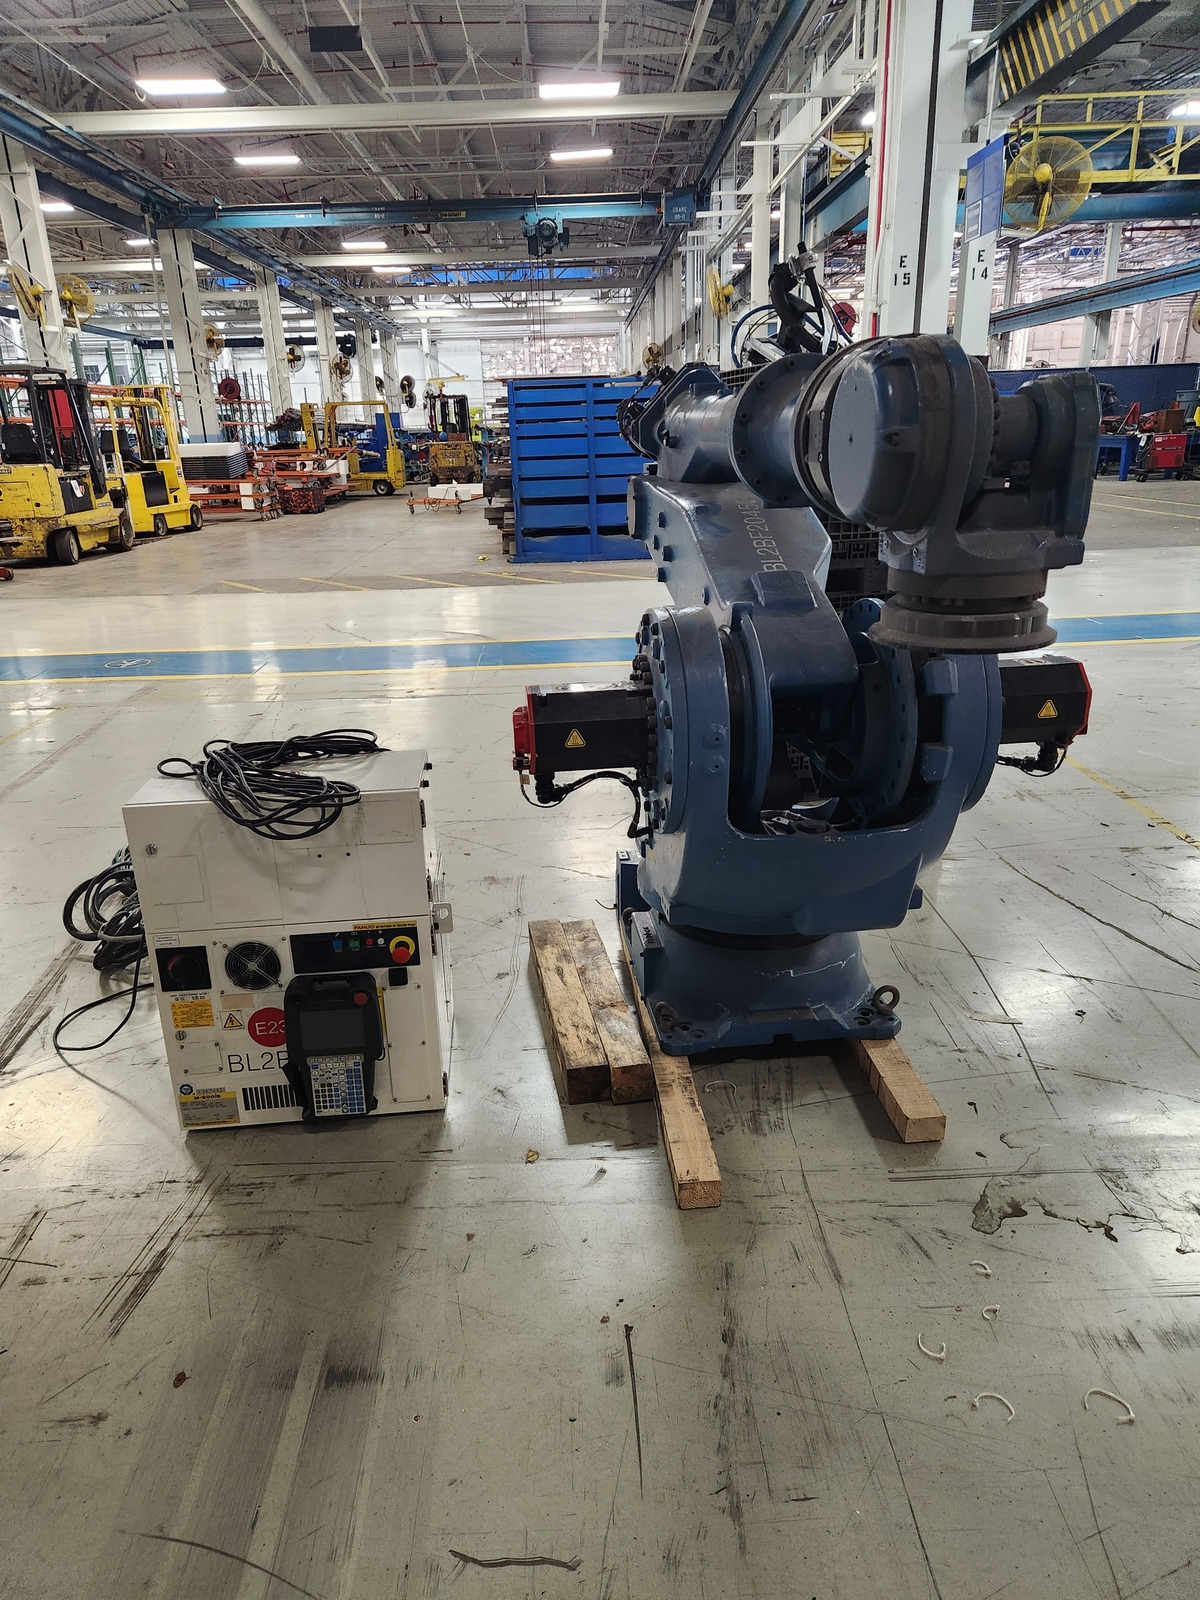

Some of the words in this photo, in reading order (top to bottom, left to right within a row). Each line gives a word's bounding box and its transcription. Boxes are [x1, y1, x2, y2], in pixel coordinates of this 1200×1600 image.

[899, 254, 908, 269] E
[977, 249, 986, 263] E
[893, 272, 911, 286] 15
[971, 267, 988, 281] 14
[306, 429, 312, 438] 2
[255, 1019, 286, 1036] E23
